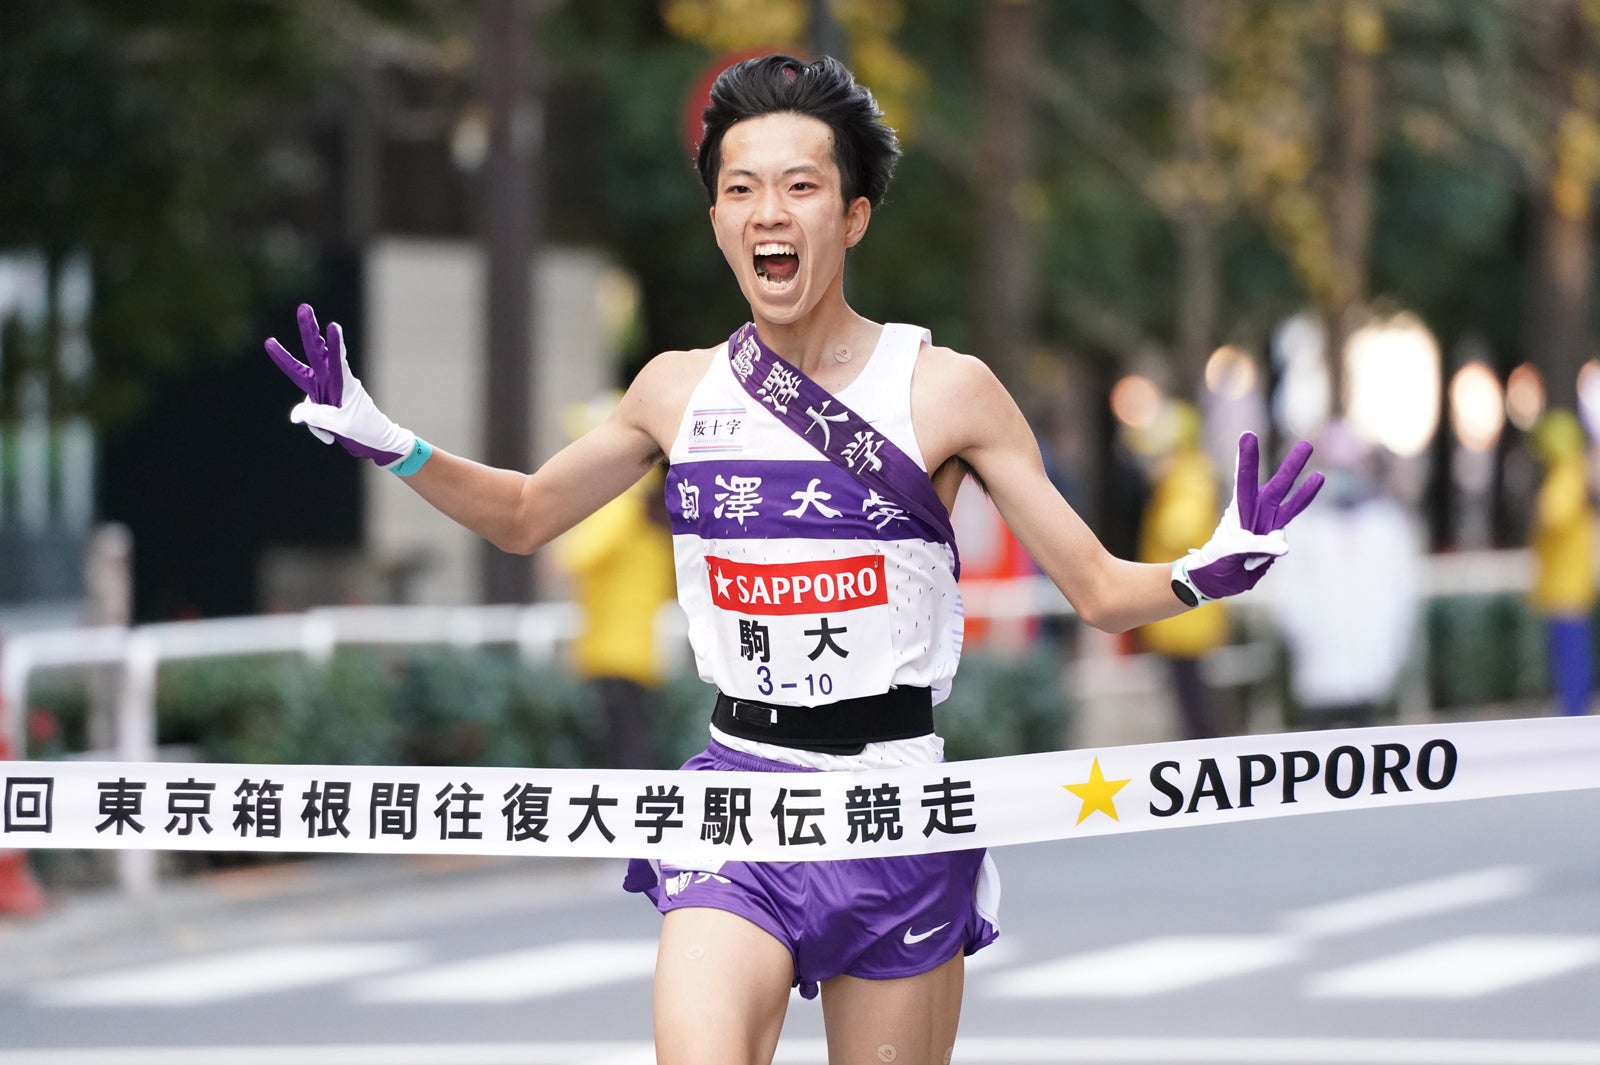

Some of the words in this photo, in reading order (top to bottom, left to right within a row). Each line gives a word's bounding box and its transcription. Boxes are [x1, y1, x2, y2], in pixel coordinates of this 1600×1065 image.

[693, 419, 742, 436] 桜十字
[736, 566, 878, 605] SAPPORO
[1148, 738, 1458, 818] SAPPORO
